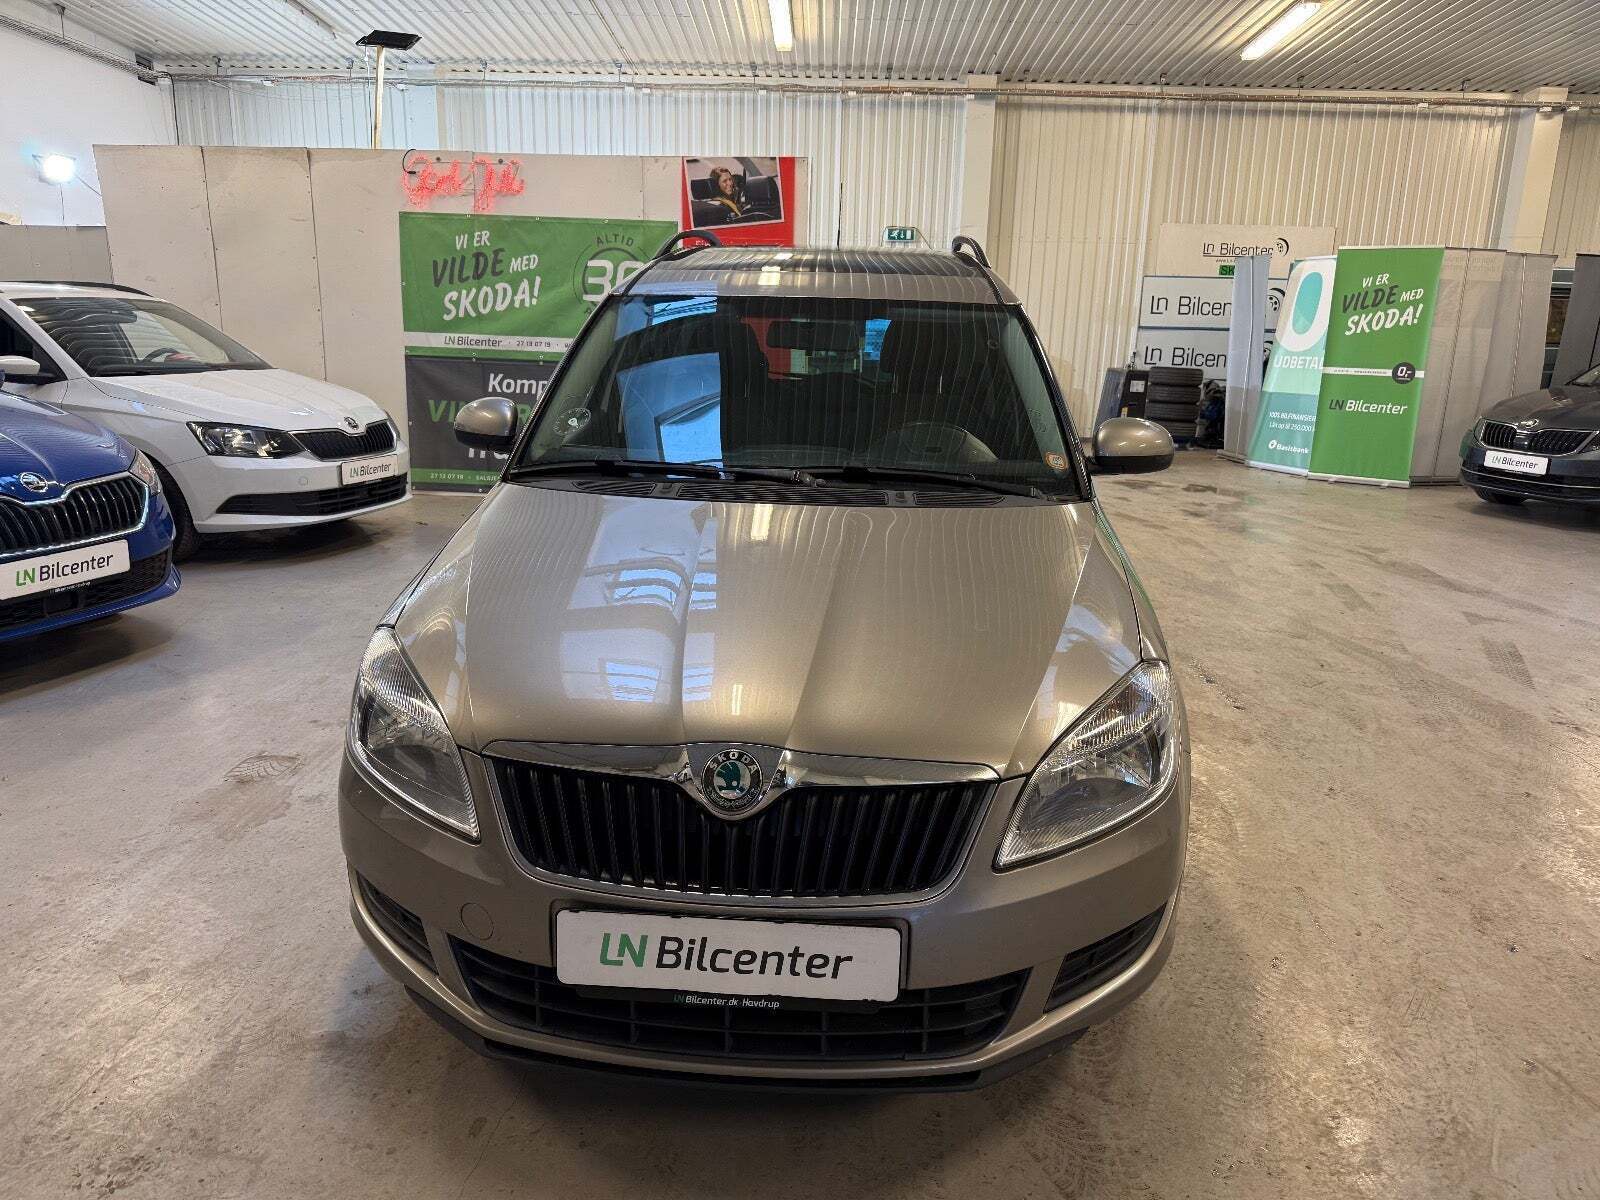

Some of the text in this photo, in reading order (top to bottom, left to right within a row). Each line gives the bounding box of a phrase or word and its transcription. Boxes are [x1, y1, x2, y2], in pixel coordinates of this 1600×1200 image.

[456, 231, 490, 250] VI ER
[596, 233, 634, 247] ALTID
[1220, 242, 1274, 256] Bilcenter
[432, 248, 538, 288] VILDE MED
[1362, 273, 1389, 288] VI ER
[443, 276, 541, 320] SKODA!
[1342, 285, 1424, 313] VILDE MED
[1344, 303, 1424, 336] SKODA!
[444, 336, 456, 345] LN
[457, 336, 503, 347] Bilcenter
[1171, 347, 1227, 368] Bilcen
[1329, 400, 1408, 414] LN Bilcenter
[1277, 443, 1309, 454] Basisbank
[350, 463, 391, 478] LN Bilcenter
[1501, 457, 1538, 469] Bilcenter
[16, 551, 113, 586] LN Bilcenter
[600, 933, 853, 979] LN Bilcenter
[685, 995, 739, 1006] Bilcenter.dk
[742, 998, 780, 1009] Havdrup
